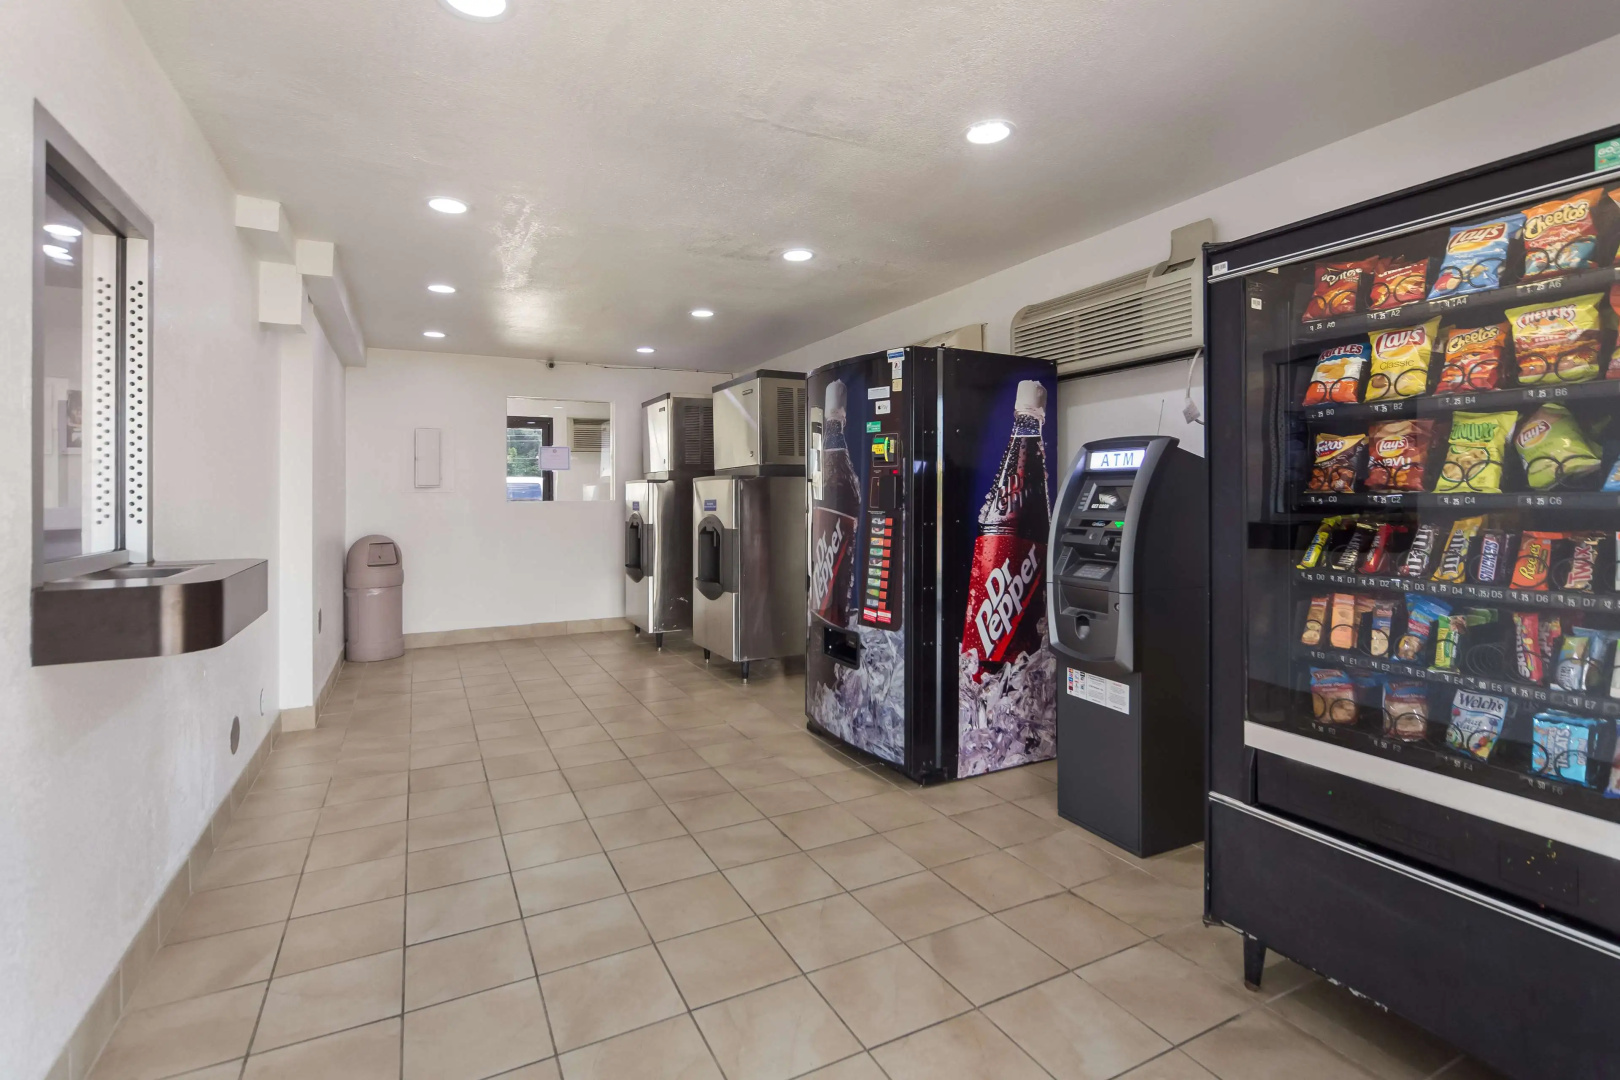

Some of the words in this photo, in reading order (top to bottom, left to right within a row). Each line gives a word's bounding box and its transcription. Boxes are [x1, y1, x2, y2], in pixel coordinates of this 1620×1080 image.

[1524, 200, 1589, 240] Cheetos
[1548, 280, 1562, 289] A6
[1456, 297, 1467, 305] A4
[1390, 309, 1401, 317] A2
[1448, 325, 1500, 353] Cheetos
[1380, 359, 1415, 370] Classic
[1554, 388, 1568, 396] B6
[1465, 396, 1476, 404] B4
[1393, 402, 1403, 410] B2
[1100, 452, 1134, 467] ATM
[1391, 496, 1401, 504] C2
[1464, 496, 1476, 504] C4
[1549, 496, 1562, 505] C6
[816, 530, 828, 569] Dr
[813, 517, 843, 610] Pepper
[1479, 539, 1499, 582] SNICKERS
[985, 557, 1012, 609] Dr
[1347, 576, 1356, 584] D1
[1414, 583, 1425, 591] D3
[1452, 587, 1463, 595] D4
[1491, 590, 1503, 599] D5
[1535, 594, 1549, 603] D6
[975, 543, 1038, 659] Pepper
[1583, 598, 1597, 607] D7
[1317, 651, 1325, 659] E0
[1349, 657, 1358, 665] E1
[1381, 664, 1391, 672] E2
[1416, 670, 1426, 678] E3
[1453, 676, 1464, 686] E4
[1491, 683, 1503, 692] E5
[1534, 691, 1546, 700] E6
[1459, 692, 1504, 713] Welch's
[1584, 700, 1597, 710] E7
